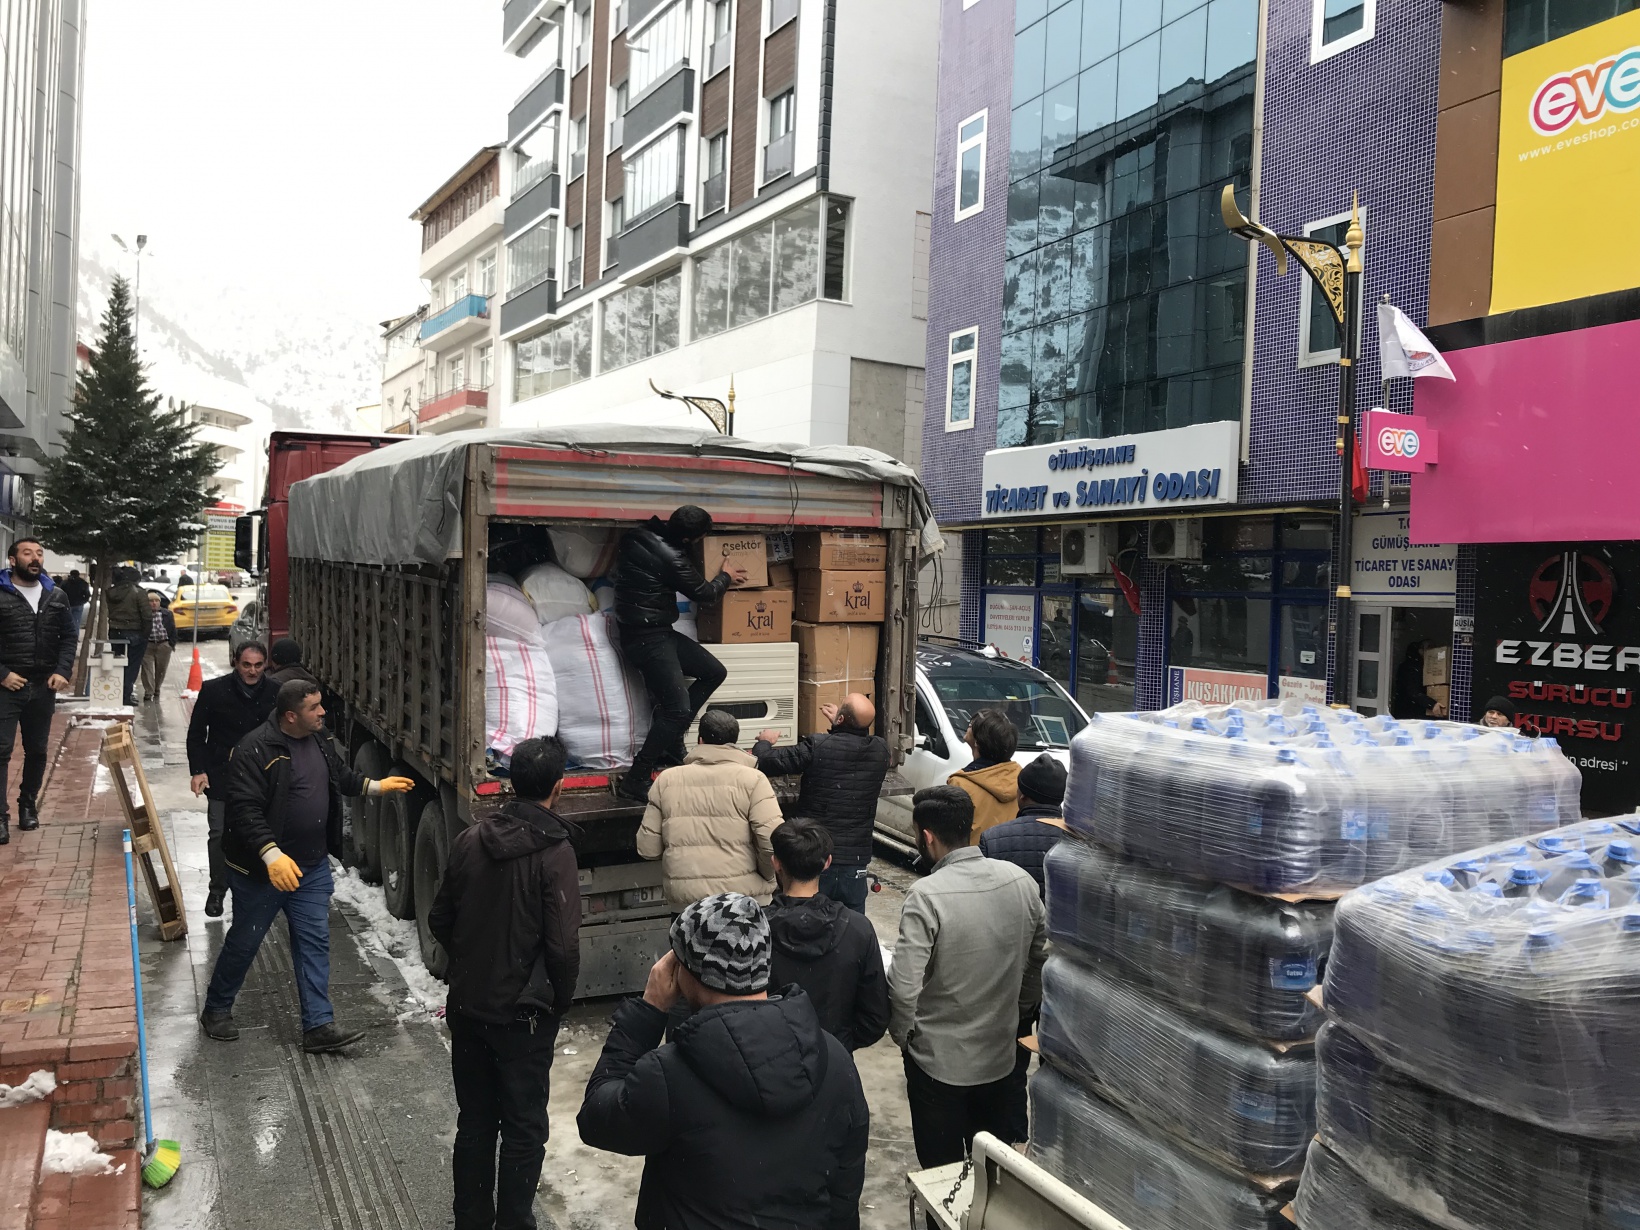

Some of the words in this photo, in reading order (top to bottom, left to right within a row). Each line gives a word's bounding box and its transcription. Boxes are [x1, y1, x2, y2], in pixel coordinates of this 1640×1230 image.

[1531, 48, 1640, 134] eve
[1378, 427, 1419, 458] eve
[1048, 444, 1136, 471] GÜMÜŞHANE
[986, 484, 1048, 513] TİCARET
[1052, 491, 1071, 508] ve
[1076, 468, 1149, 507] SANAYİ
[1153, 468, 1221, 500] ODASI
[730, 539, 761, 550] sektör
[1355, 557, 1398, 572] TİCARET
[1401, 559, 1415, 571] VE
[1388, 575, 1420, 588] ODASI
[844, 590, 870, 610] kral
[747, 610, 773, 630] kral
[1496, 639, 1640, 673] EZBER
[1508, 680, 1632, 709] SÜRÜCÜ
[1514, 713, 1622, 741] KURSU
[1580, 756, 1618, 771] adresi
